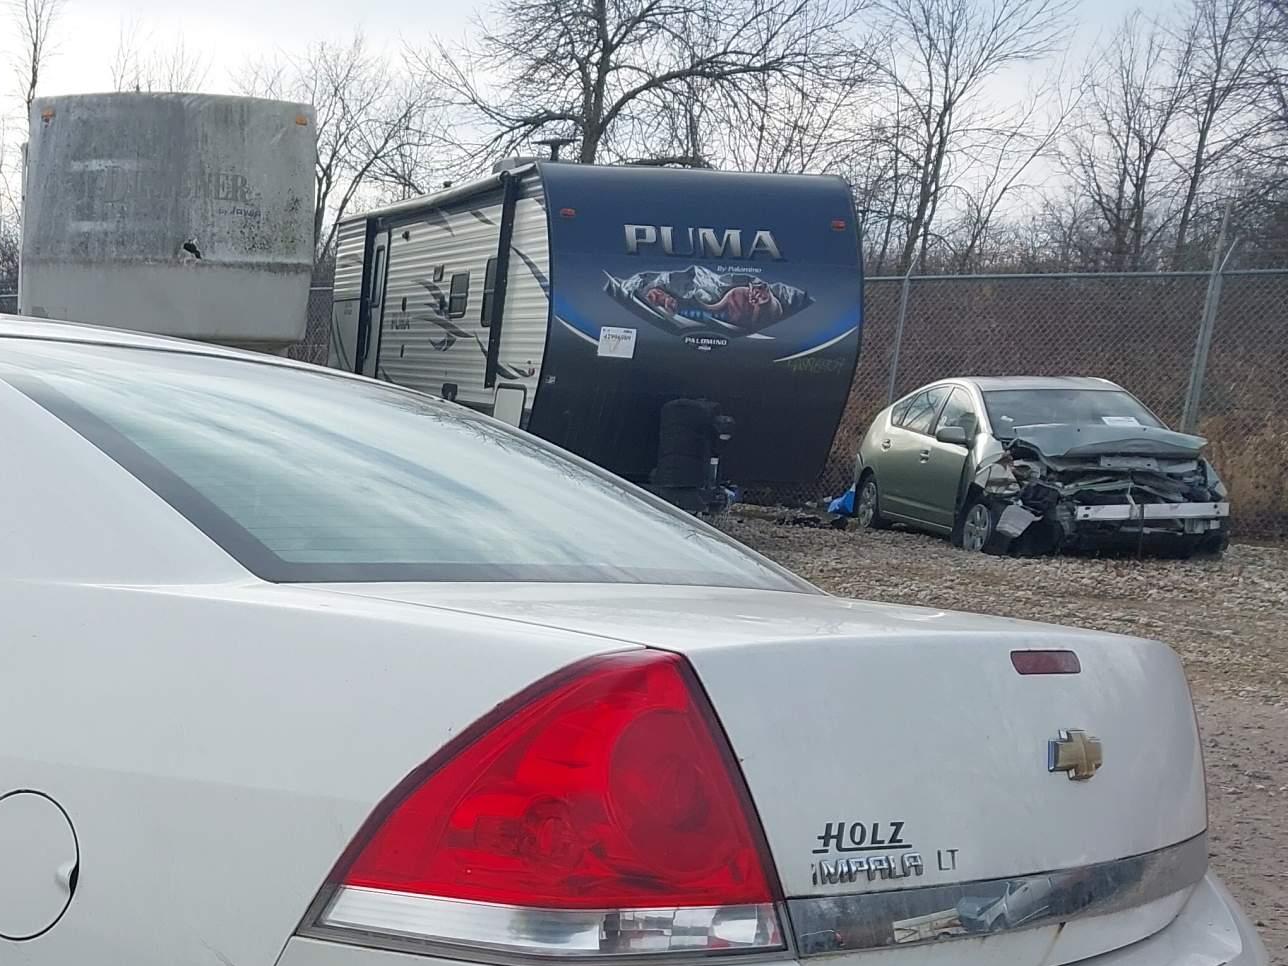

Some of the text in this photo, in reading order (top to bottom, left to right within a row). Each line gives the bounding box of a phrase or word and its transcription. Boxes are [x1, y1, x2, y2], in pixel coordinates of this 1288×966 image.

[623, 223, 784, 260] PUMA
[684, 336, 728, 346] PALOMINO
[815, 821, 906, 850] HOLZ
[811, 848, 959, 886] IMPALA LT
